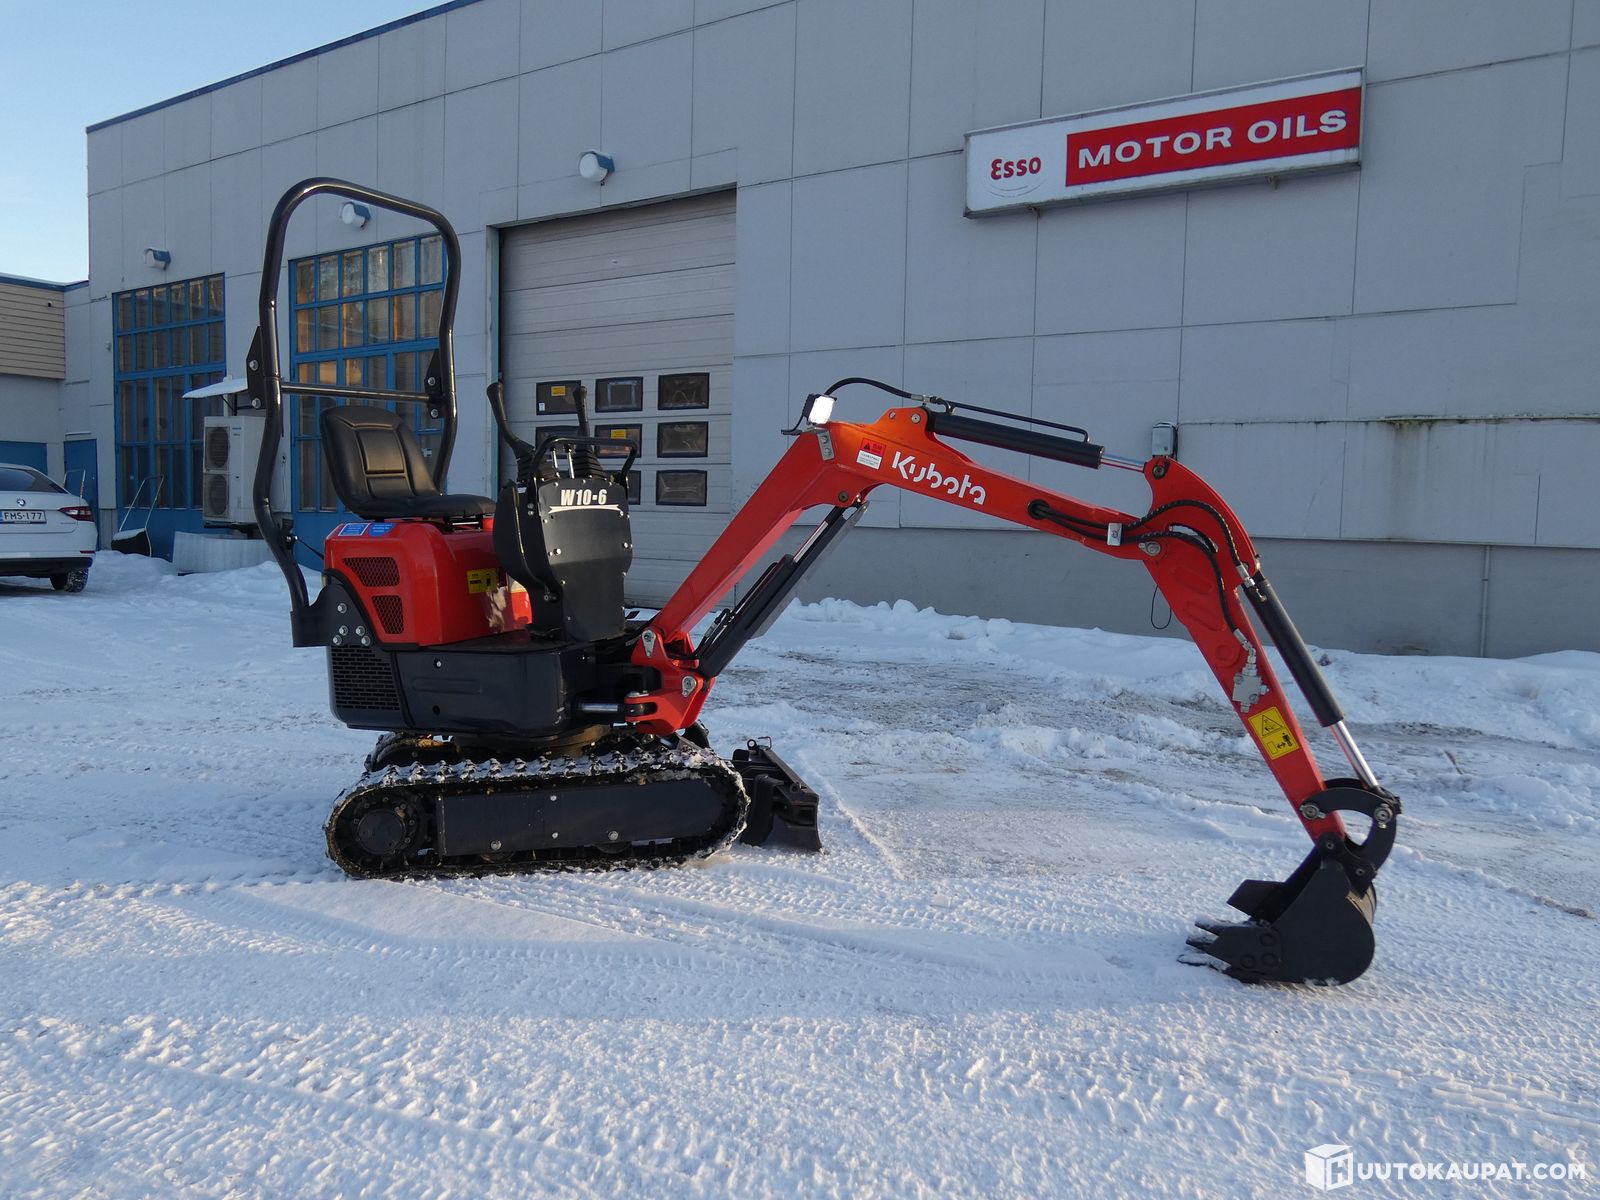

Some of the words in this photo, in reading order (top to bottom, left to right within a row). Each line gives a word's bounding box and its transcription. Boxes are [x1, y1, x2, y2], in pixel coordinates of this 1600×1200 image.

[1078, 126, 1232, 169] MOTOR
[1247, 109, 1347, 144] OILS
[561, 489, 608, 506] W10-6
[892, 451, 986, 505] Kubota
